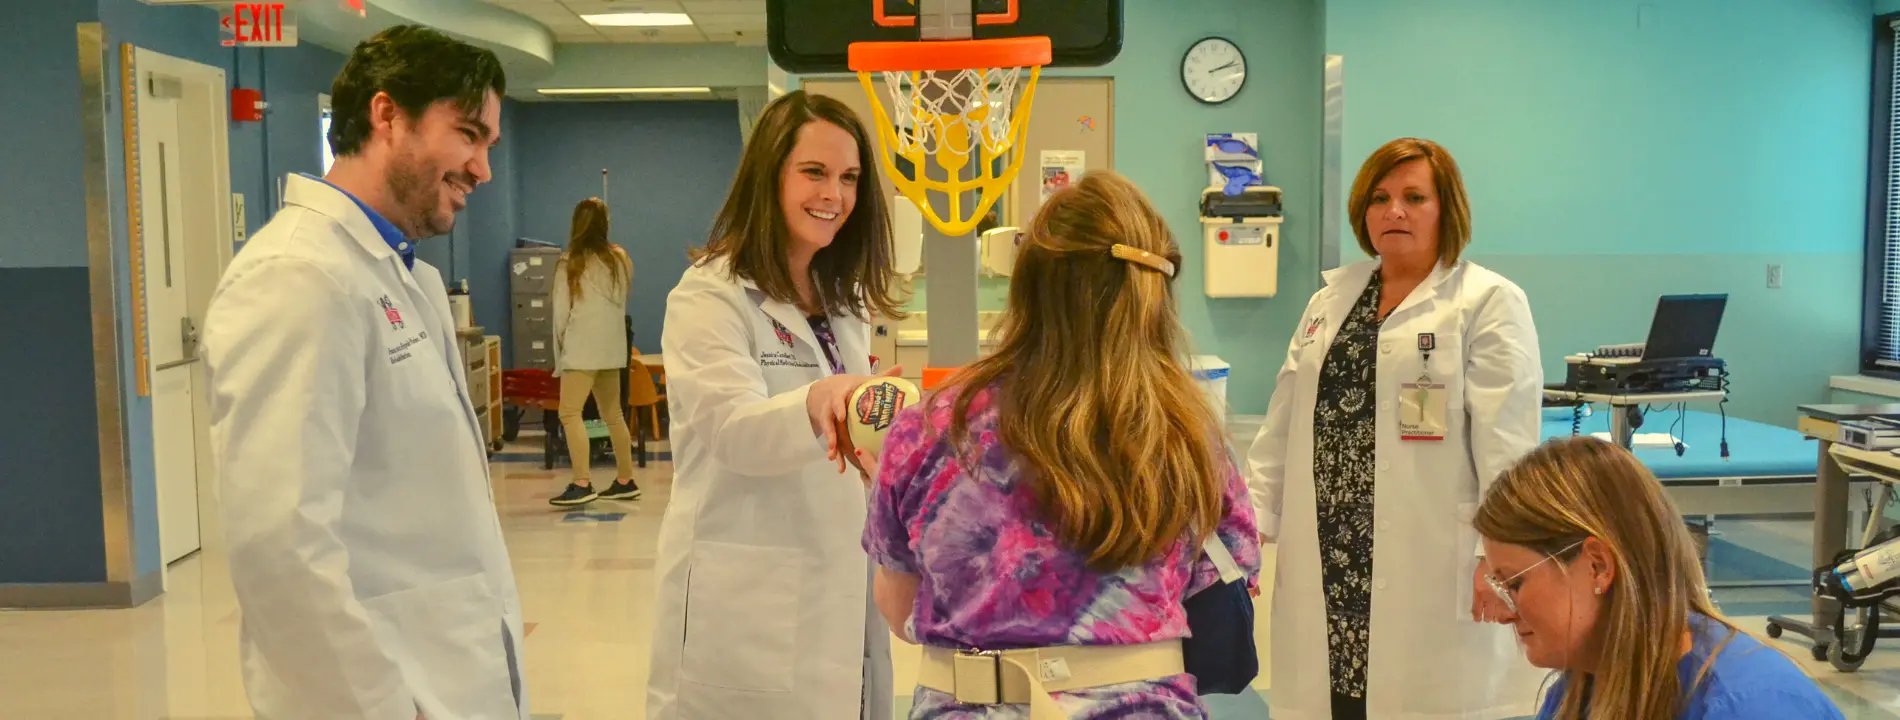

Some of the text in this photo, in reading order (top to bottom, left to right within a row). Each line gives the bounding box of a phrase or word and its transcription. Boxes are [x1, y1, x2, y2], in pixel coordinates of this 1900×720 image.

[234, 4, 284, 42] EXIT
[876, 383, 895, 429] SLAM DUNK
